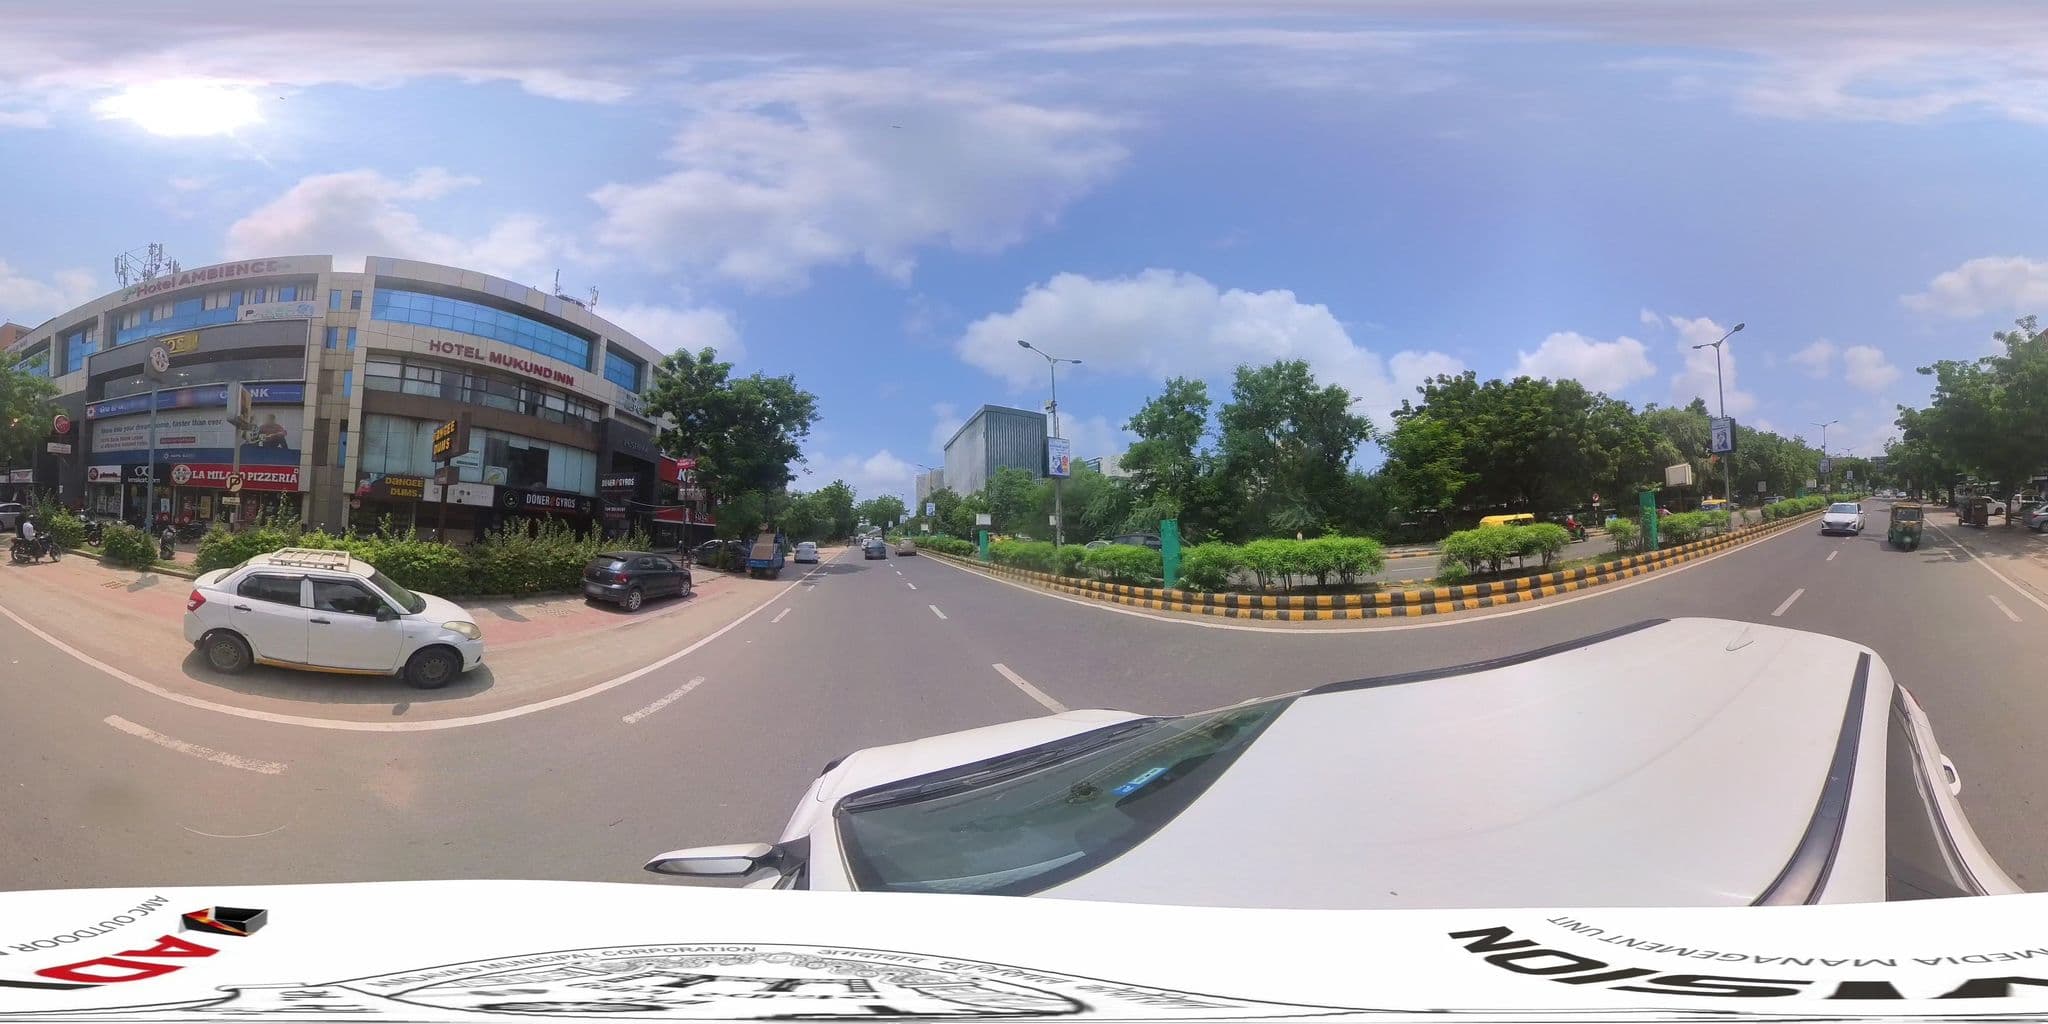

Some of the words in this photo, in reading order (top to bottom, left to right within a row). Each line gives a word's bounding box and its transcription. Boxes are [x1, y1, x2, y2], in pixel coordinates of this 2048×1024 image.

[136, 277, 177, 297] Hotel
[429, 339, 485, 361] HOTEL
[489, 351, 553, 379] MUKUND
[553, 370, 575, 387] INN
[192, 470, 206, 480] LA
[207, 471, 245, 481] MILO
[247, 471, 298, 483] PIZZERIA
[526, 493, 550, 506] DONER
[555, 497, 576, 509] GYROS
